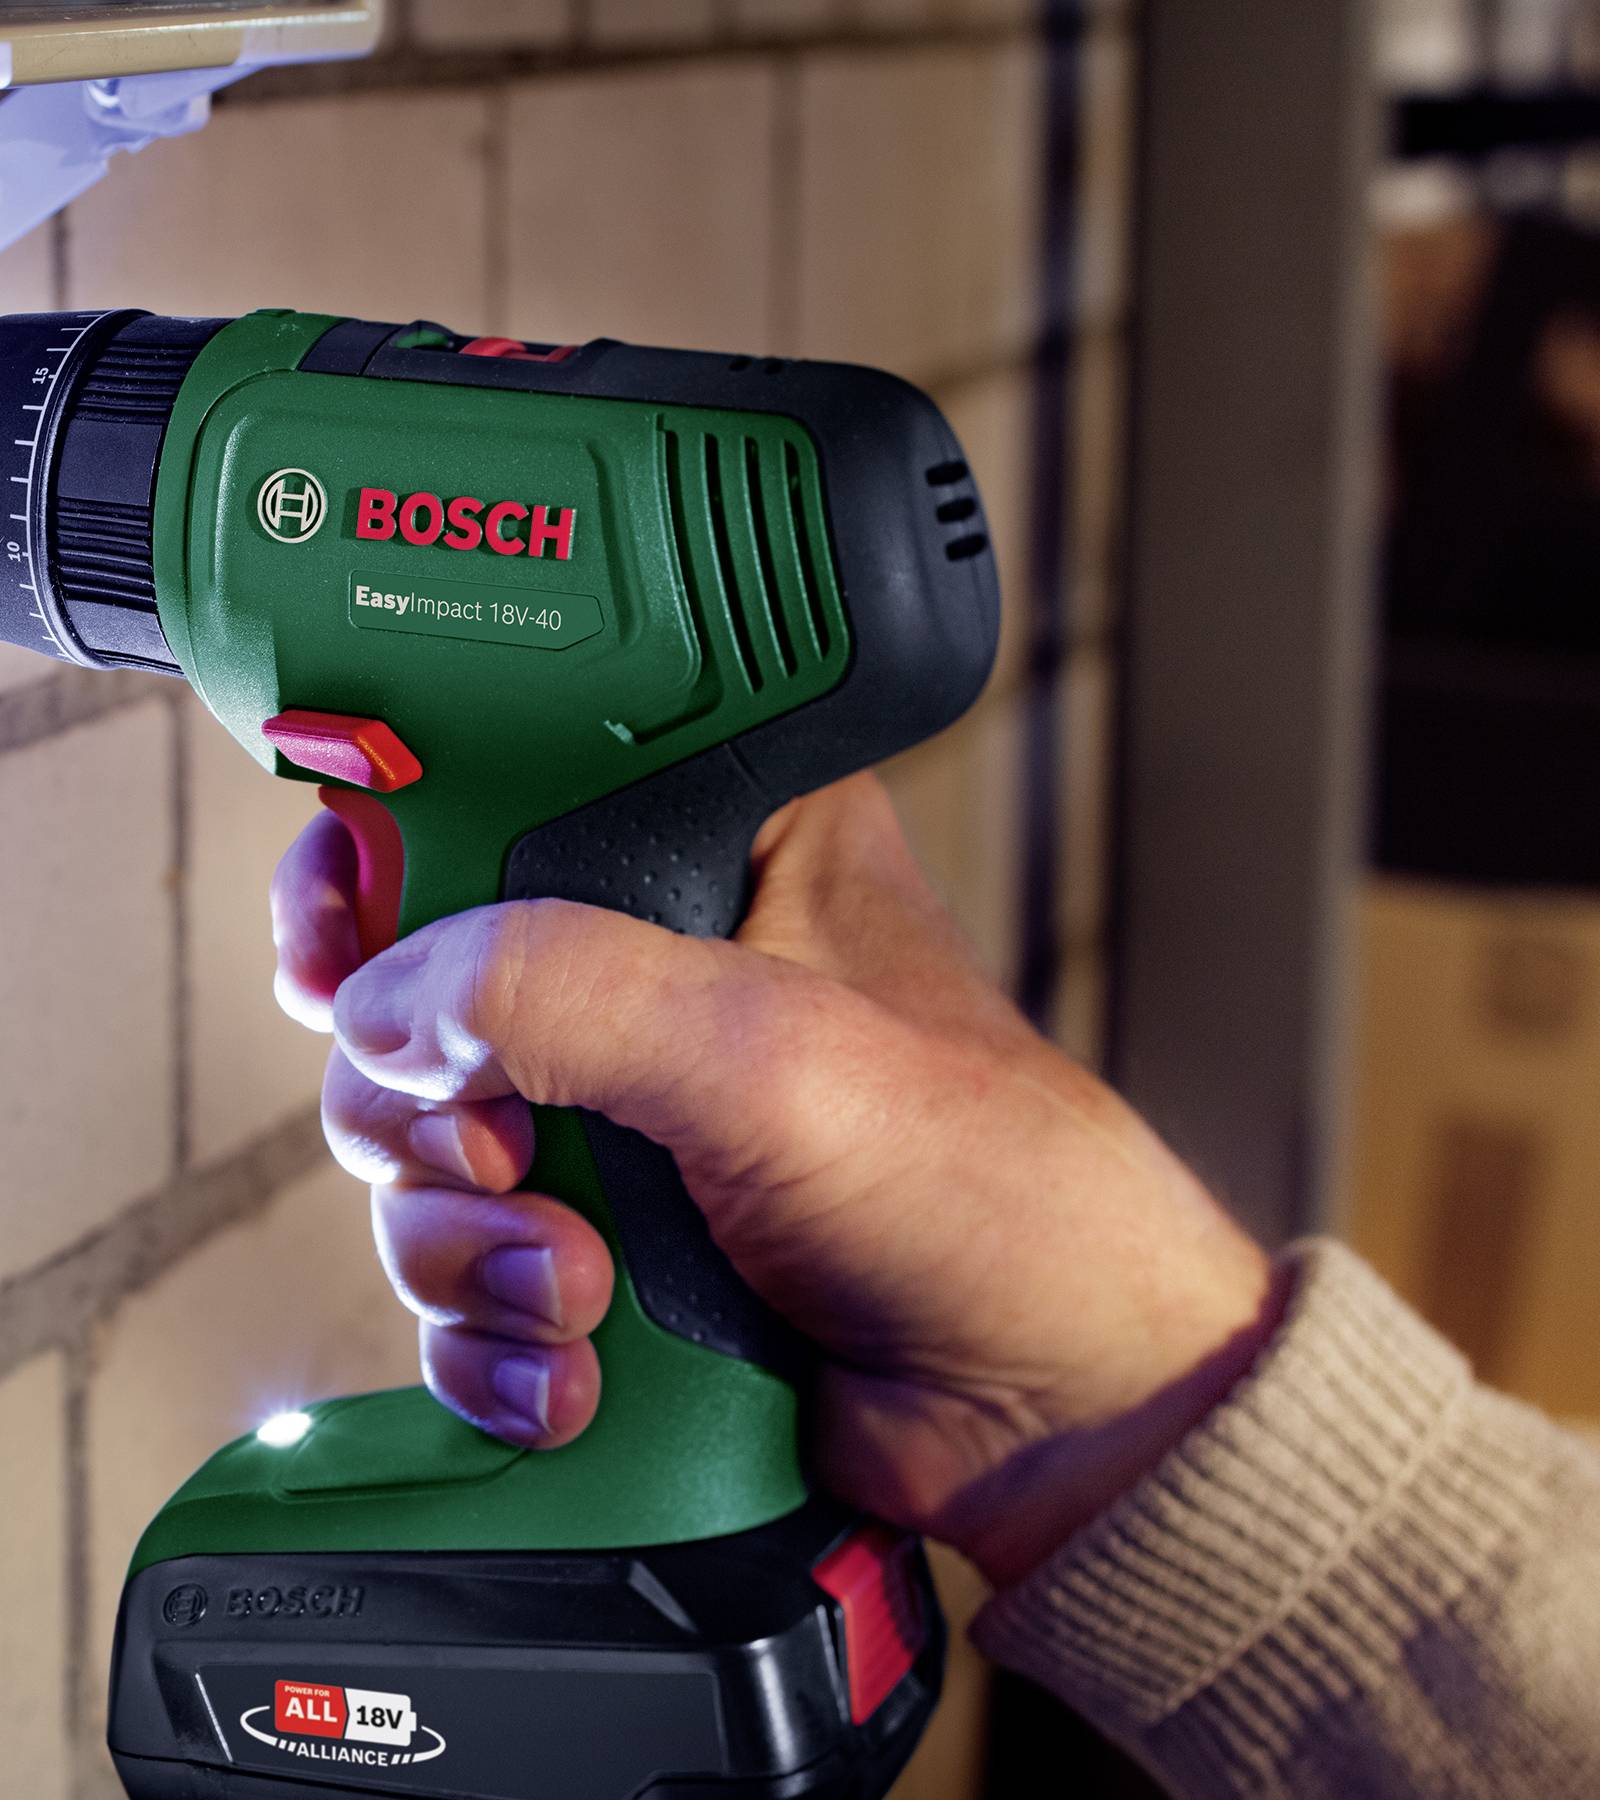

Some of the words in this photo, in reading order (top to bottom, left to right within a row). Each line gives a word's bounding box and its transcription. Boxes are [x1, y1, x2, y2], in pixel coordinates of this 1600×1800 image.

[32, 367, 49, 385] 15
[355, 487, 577, 561] BOSCH
[6, 541, 20, 562] 10
[355, 585, 482, 621] EasyImpact
[489, 602, 562, 631] 18V-40
[225, 1585, 366, 1618] BOSCH
[284, 1685, 313, 1696] POWER
[314, 1689, 330, 1698] FOR
[285, 1697, 338, 1723] ALL
[356, 1705, 403, 1730] 18V
[296, 1742, 389, 1767] ALLIANCE
